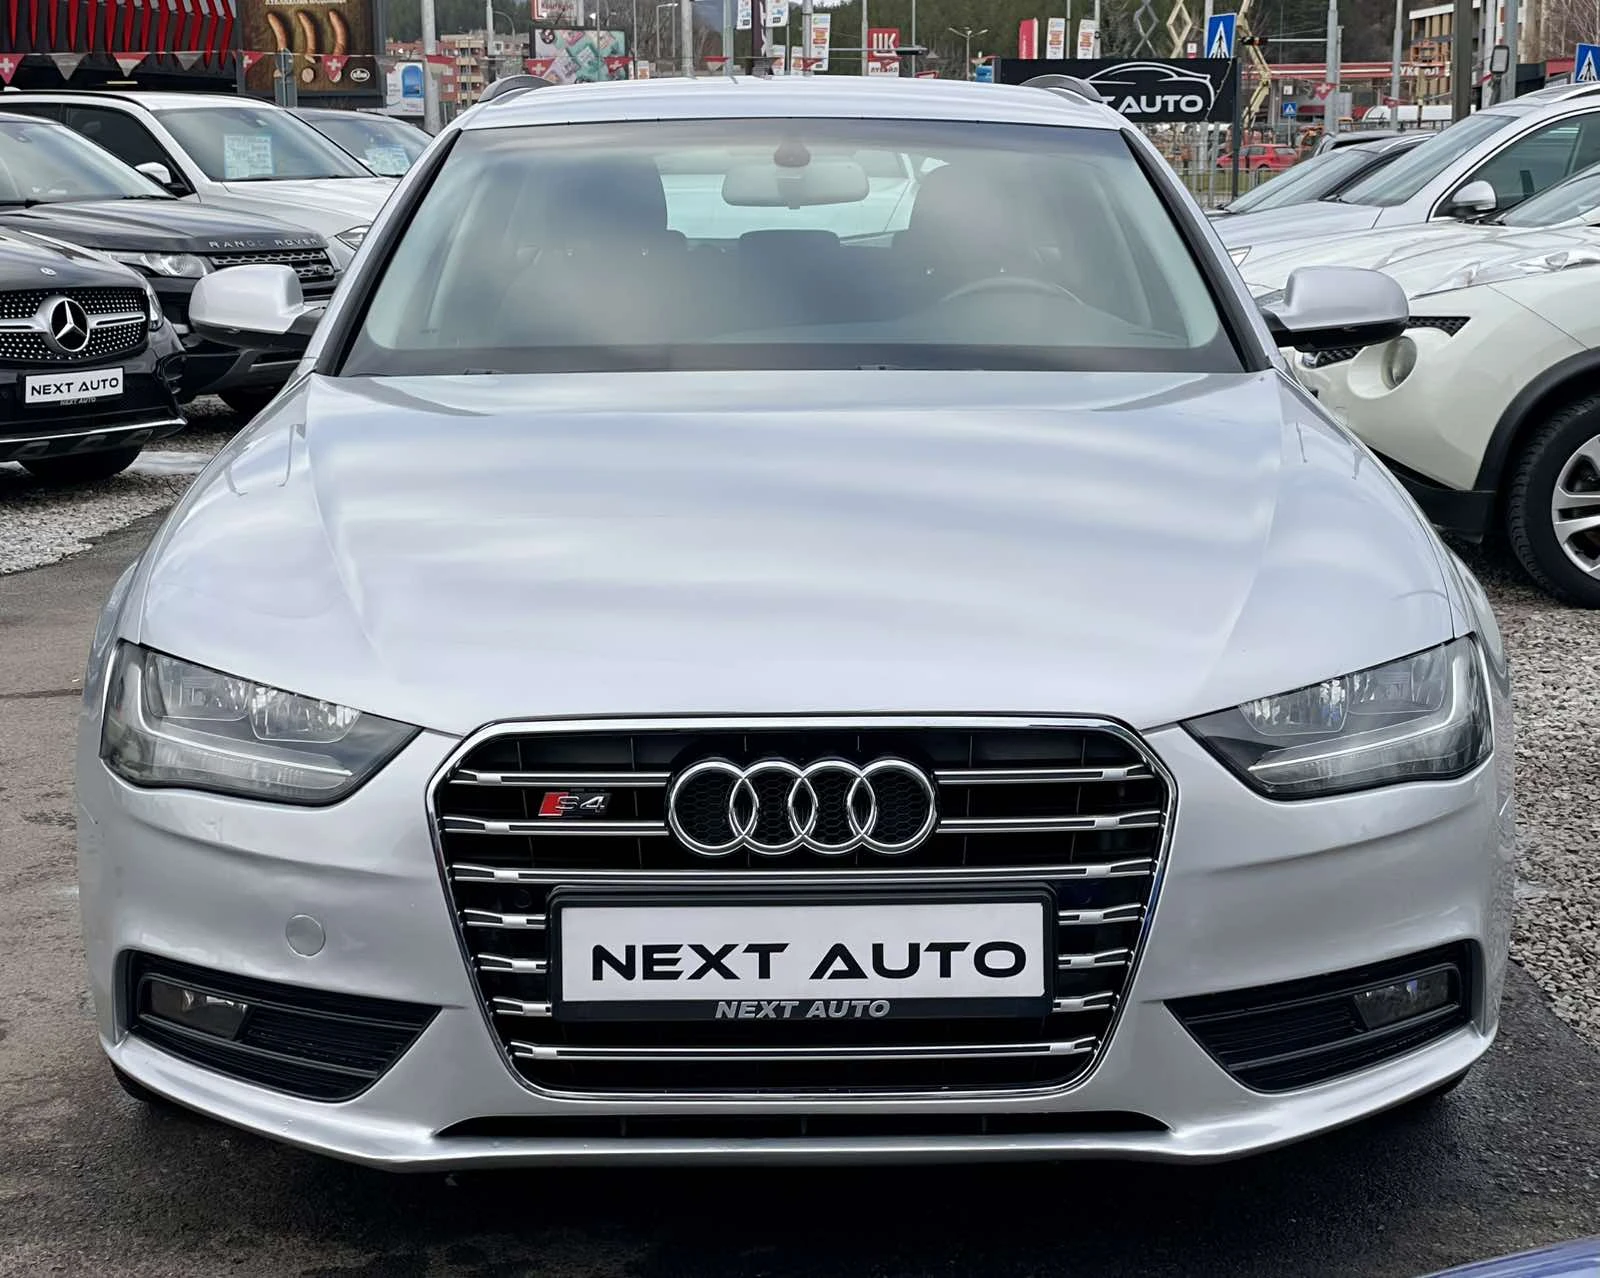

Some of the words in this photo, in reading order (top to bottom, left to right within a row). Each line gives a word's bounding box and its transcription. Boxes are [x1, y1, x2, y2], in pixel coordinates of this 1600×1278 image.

[1117, 94, 1204, 113] AUTO
[208, 239, 265, 248] RANGE
[274, 238, 318, 246] ROVER
[31, 382, 74, 396] NEXT
[78, 377, 119, 392] AUTO
[555, 795, 606, 813] S4
[592, 943, 790, 981] NEXT
[809, 941, 1026, 980] AUTO
[714, 1001, 799, 1019] NEXT
[806, 999, 891, 1018] AUTO
